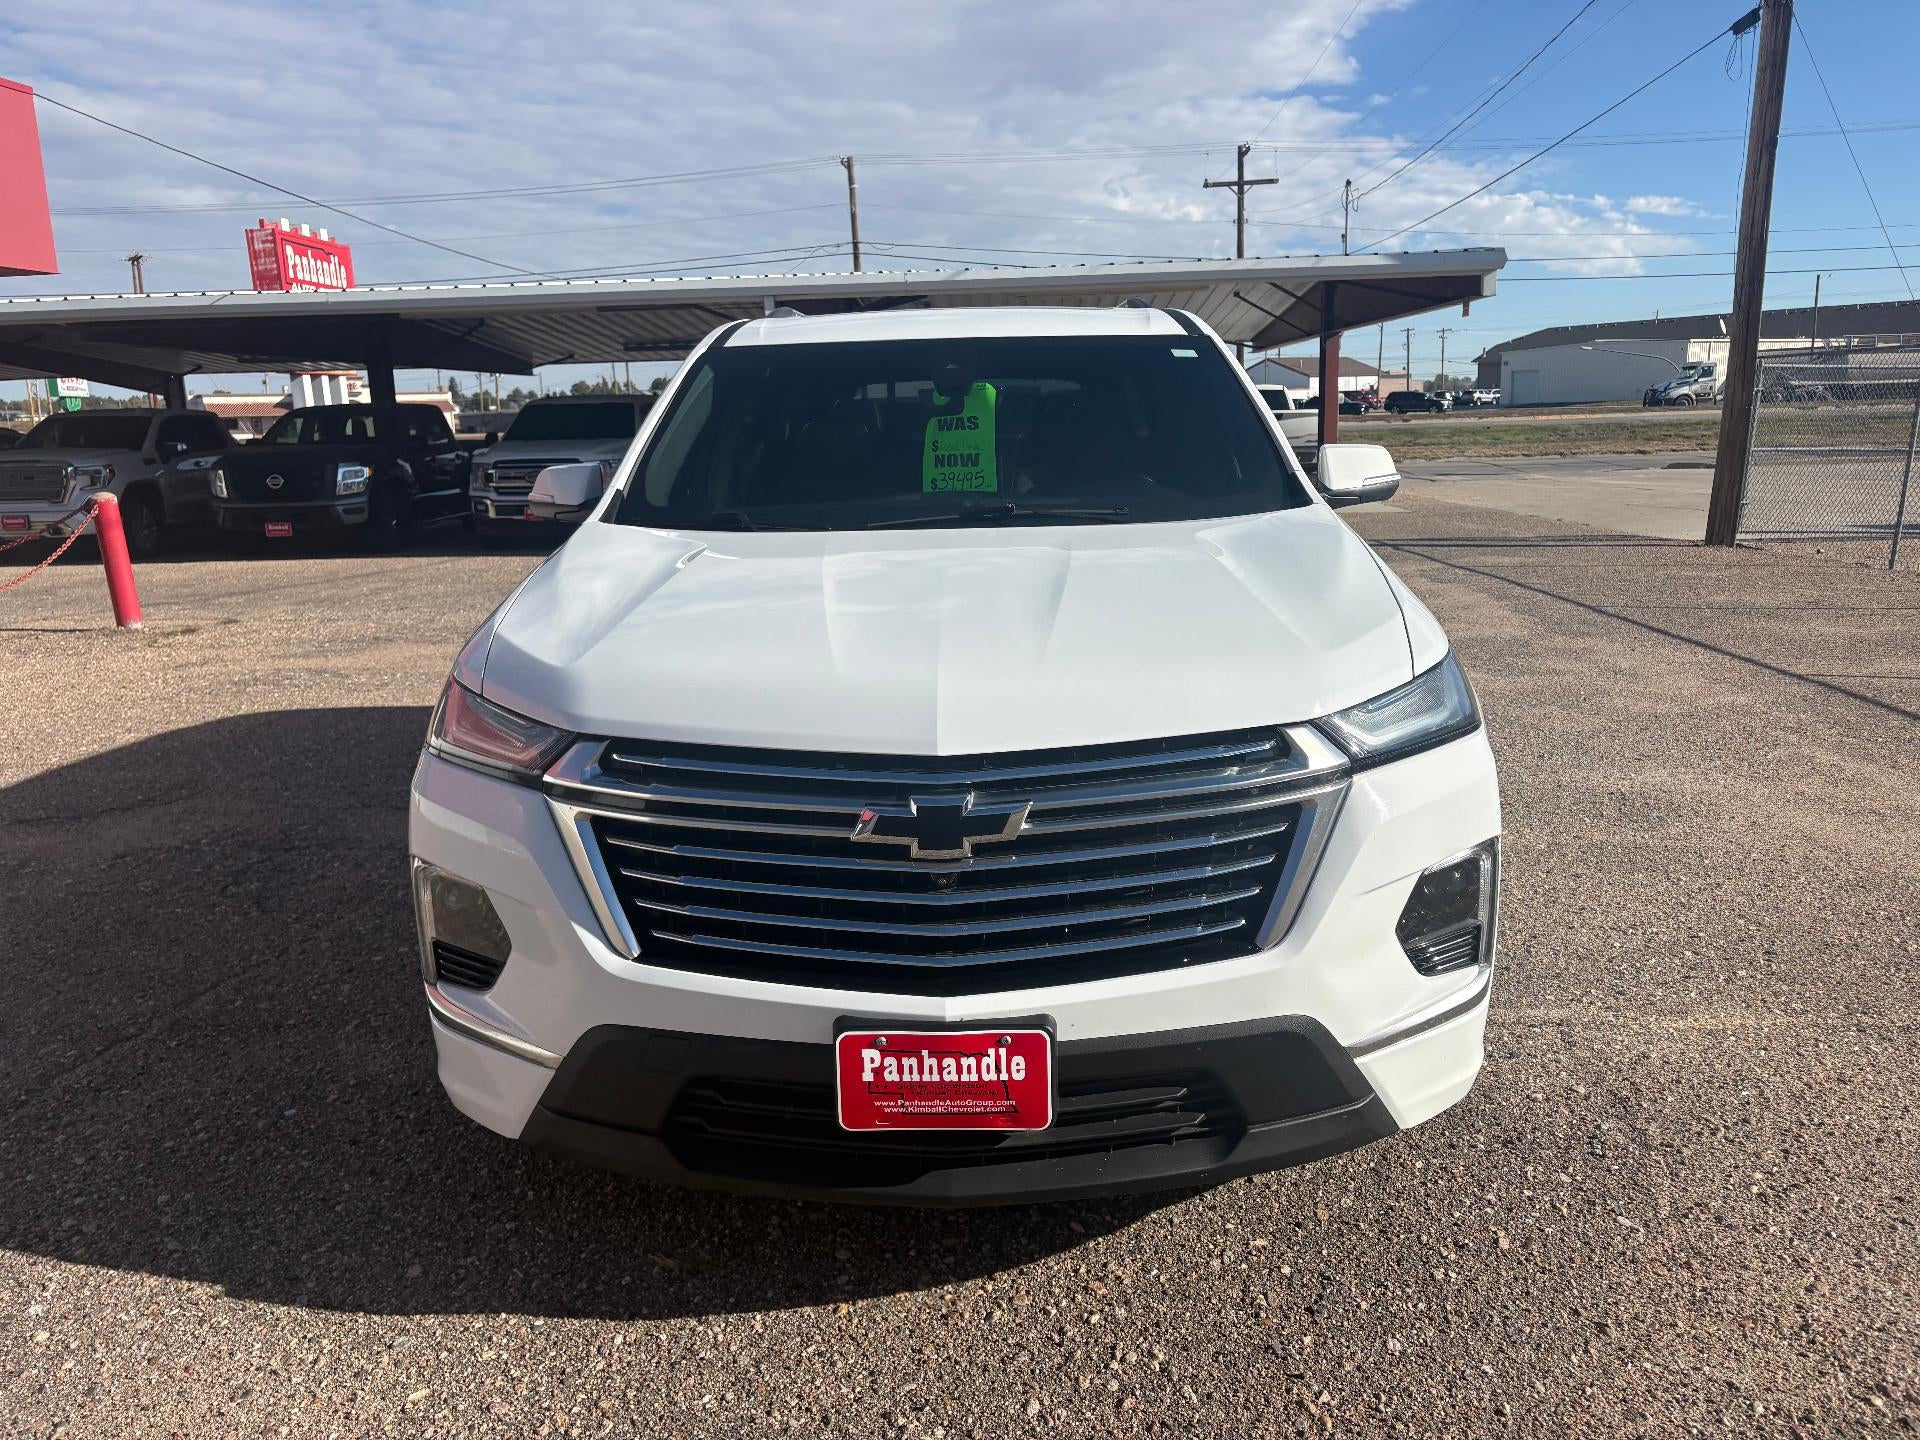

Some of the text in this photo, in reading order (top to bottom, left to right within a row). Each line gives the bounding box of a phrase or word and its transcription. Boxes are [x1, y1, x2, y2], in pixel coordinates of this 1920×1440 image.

[285, 244, 348, 289] Panhandle
[937, 416, 980, 431] WAS
[934, 453, 980, 469] NOW
[861, 1047, 1026, 1082] Panhandle
[874, 1099, 1016, 1107] www.PanhandleAutoGroup.com
